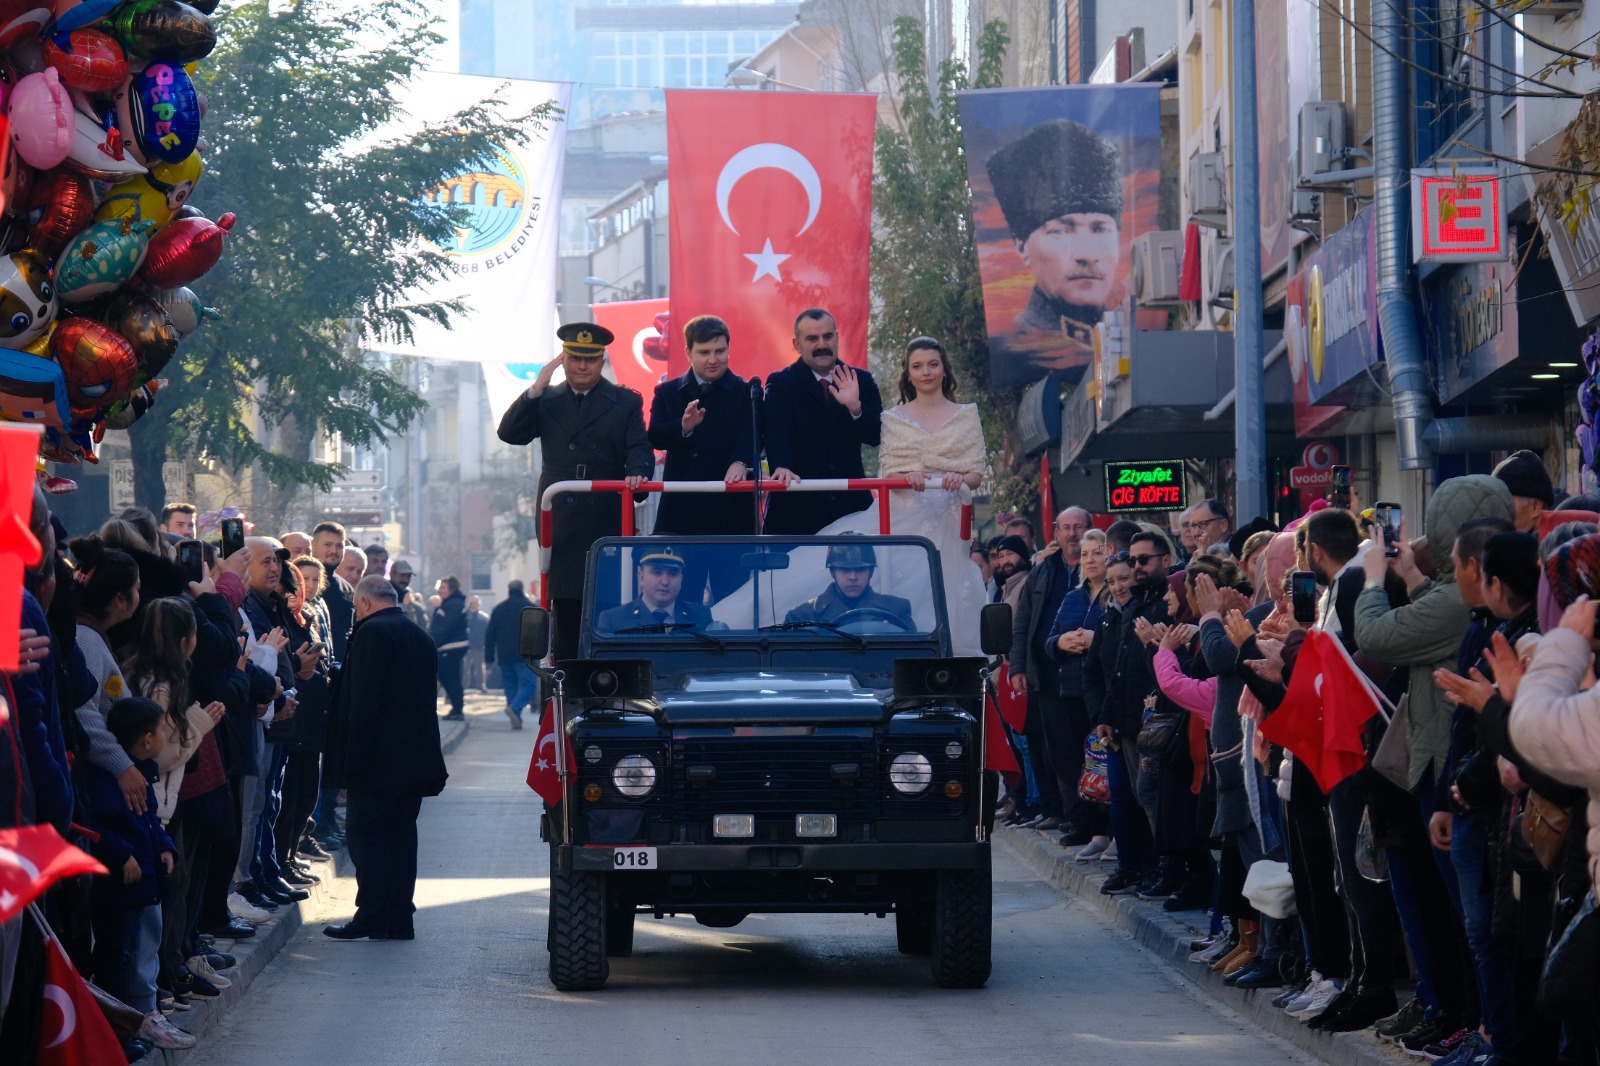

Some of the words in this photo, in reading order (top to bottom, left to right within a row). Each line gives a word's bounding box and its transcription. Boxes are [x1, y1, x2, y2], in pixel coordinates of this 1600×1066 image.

[145, 63, 181, 151] PEPEE
[1438, 187, 1486, 242] E
[453, 262, 479, 274] 868
[485, 196, 541, 270] BELEDİYESİ
[1117, 467, 1173, 486] Ziyafet
[1139, 485, 1180, 504] KÖFTE
[614, 851, 649, 867] 018
